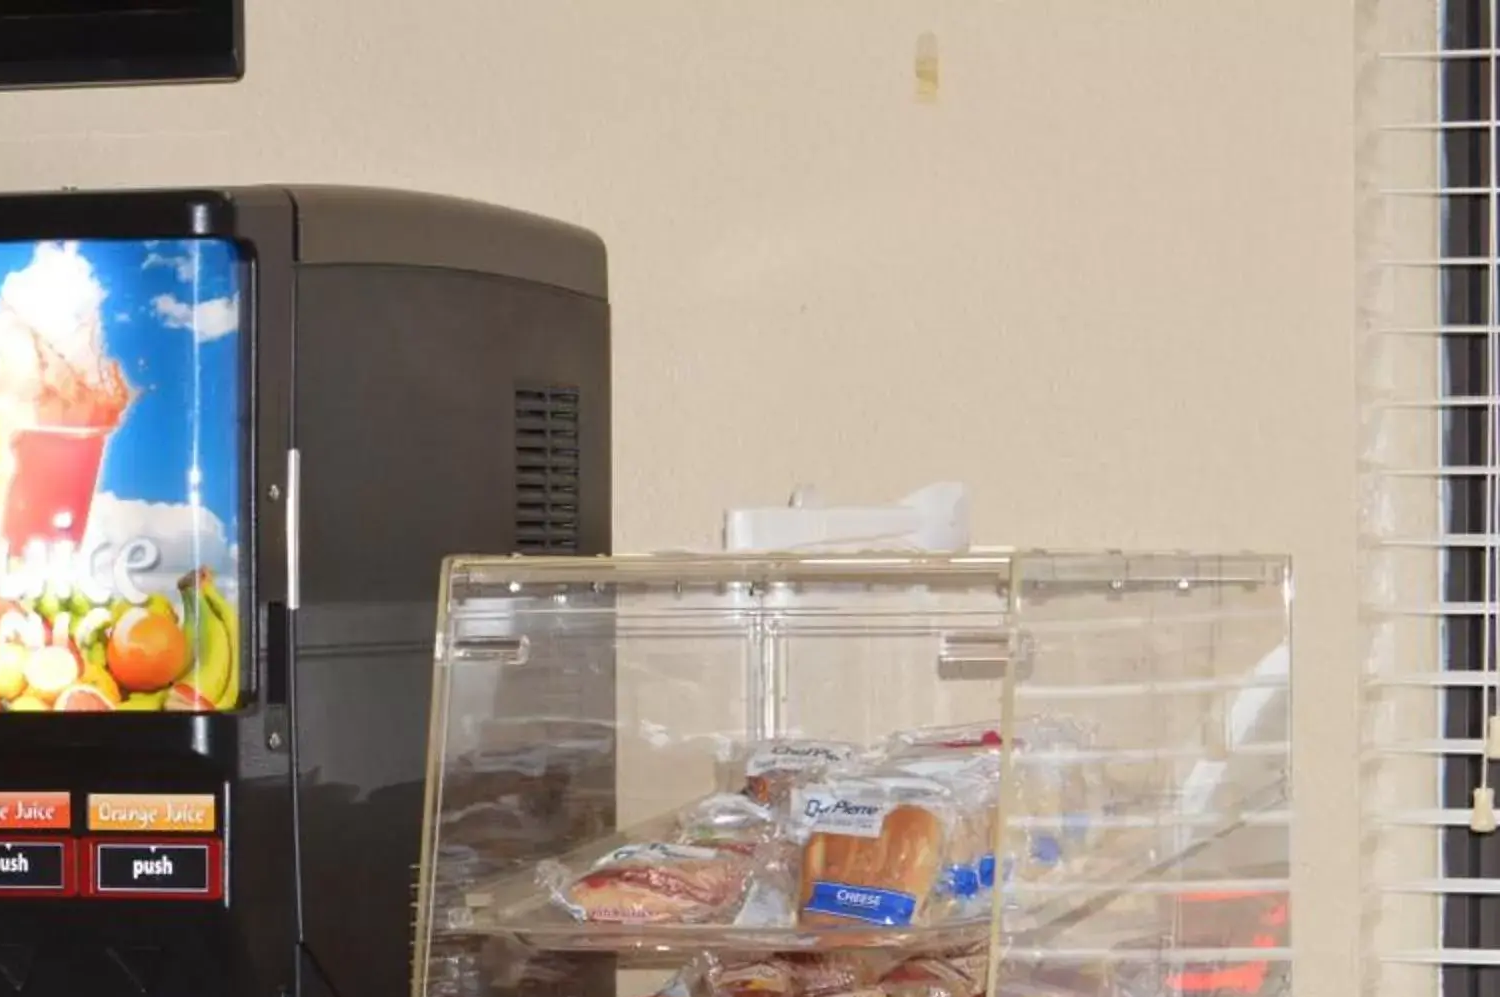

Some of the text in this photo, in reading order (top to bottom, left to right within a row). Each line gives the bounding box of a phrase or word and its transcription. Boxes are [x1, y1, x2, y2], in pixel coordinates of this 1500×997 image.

[15, 799, 56, 821] Juice
[99, 801, 206, 827] Orange Juice
[132, 855, 173, 879] push
[835, 889, 882, 906] CHEESE
